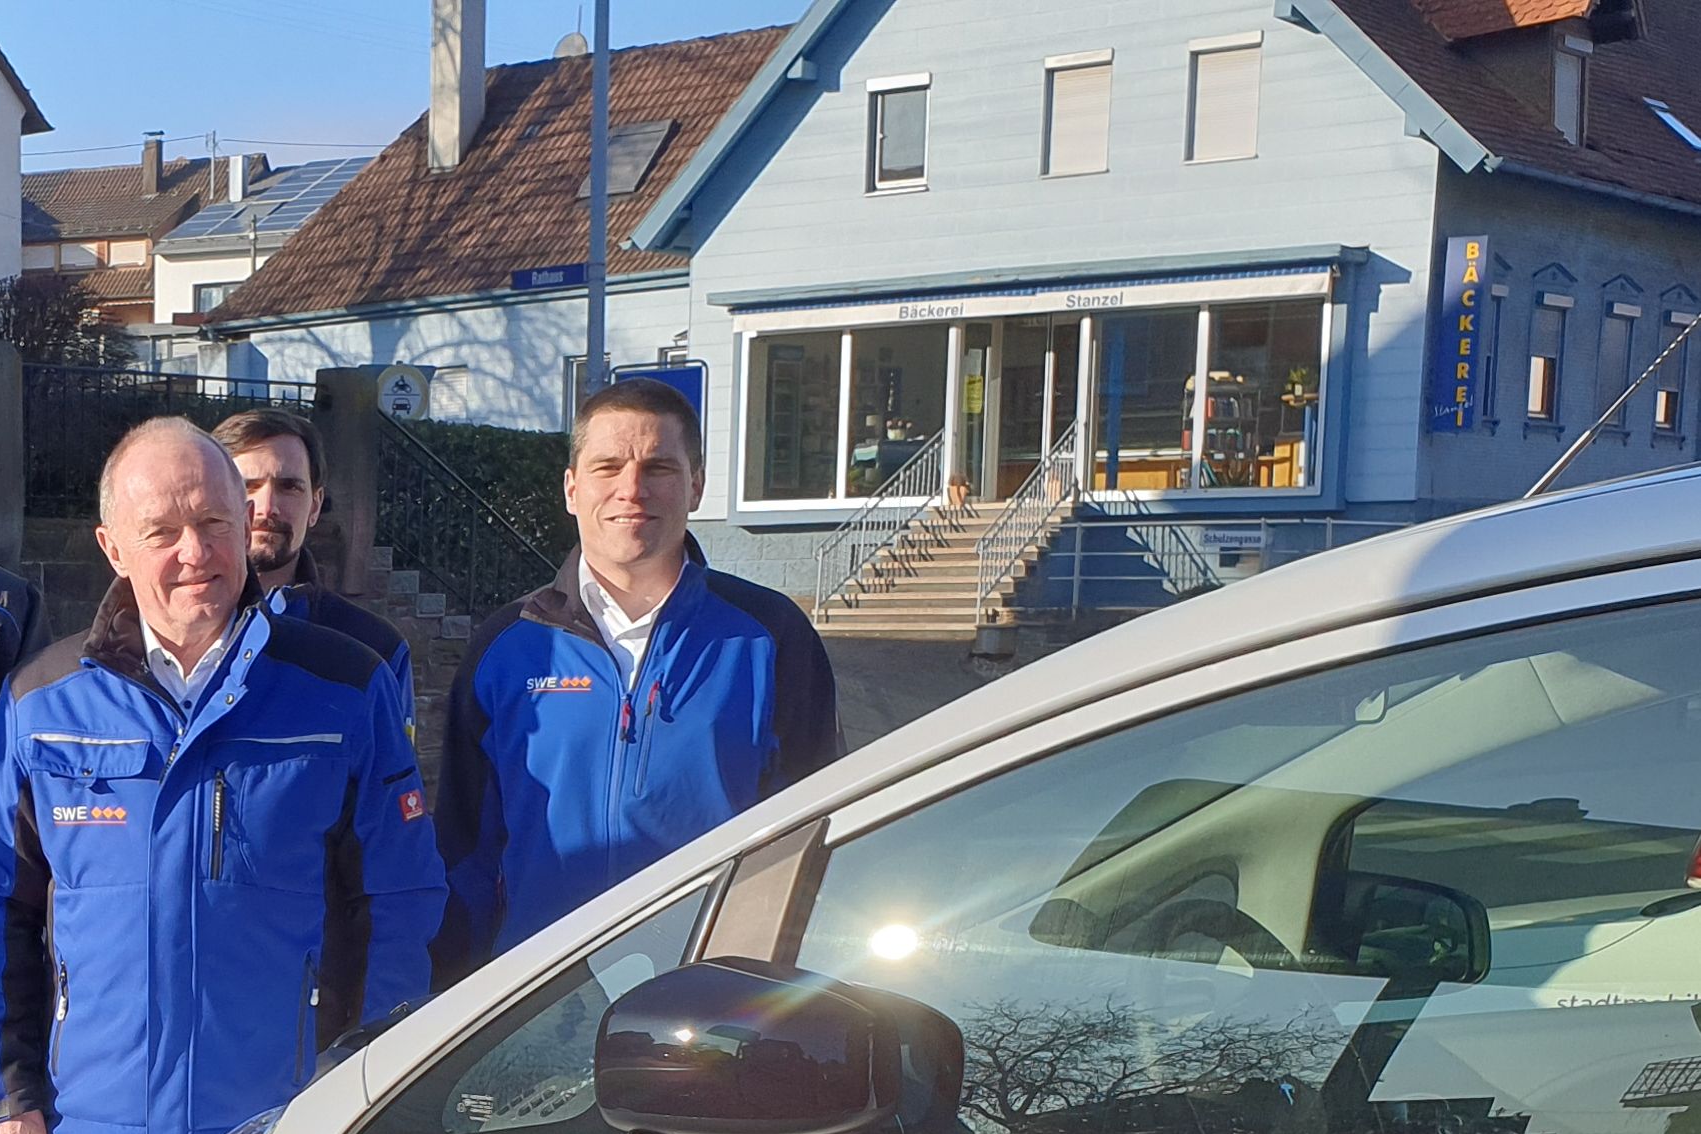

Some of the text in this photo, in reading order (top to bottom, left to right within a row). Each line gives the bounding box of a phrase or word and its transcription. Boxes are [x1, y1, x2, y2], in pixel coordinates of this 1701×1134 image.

[899, 291, 1124, 320] Bäckerei Stanzel
[1456, 242, 1480, 427] BÄCKEREI
[526, 676, 557, 690] SWE
[52, 805, 88, 821] SWE
